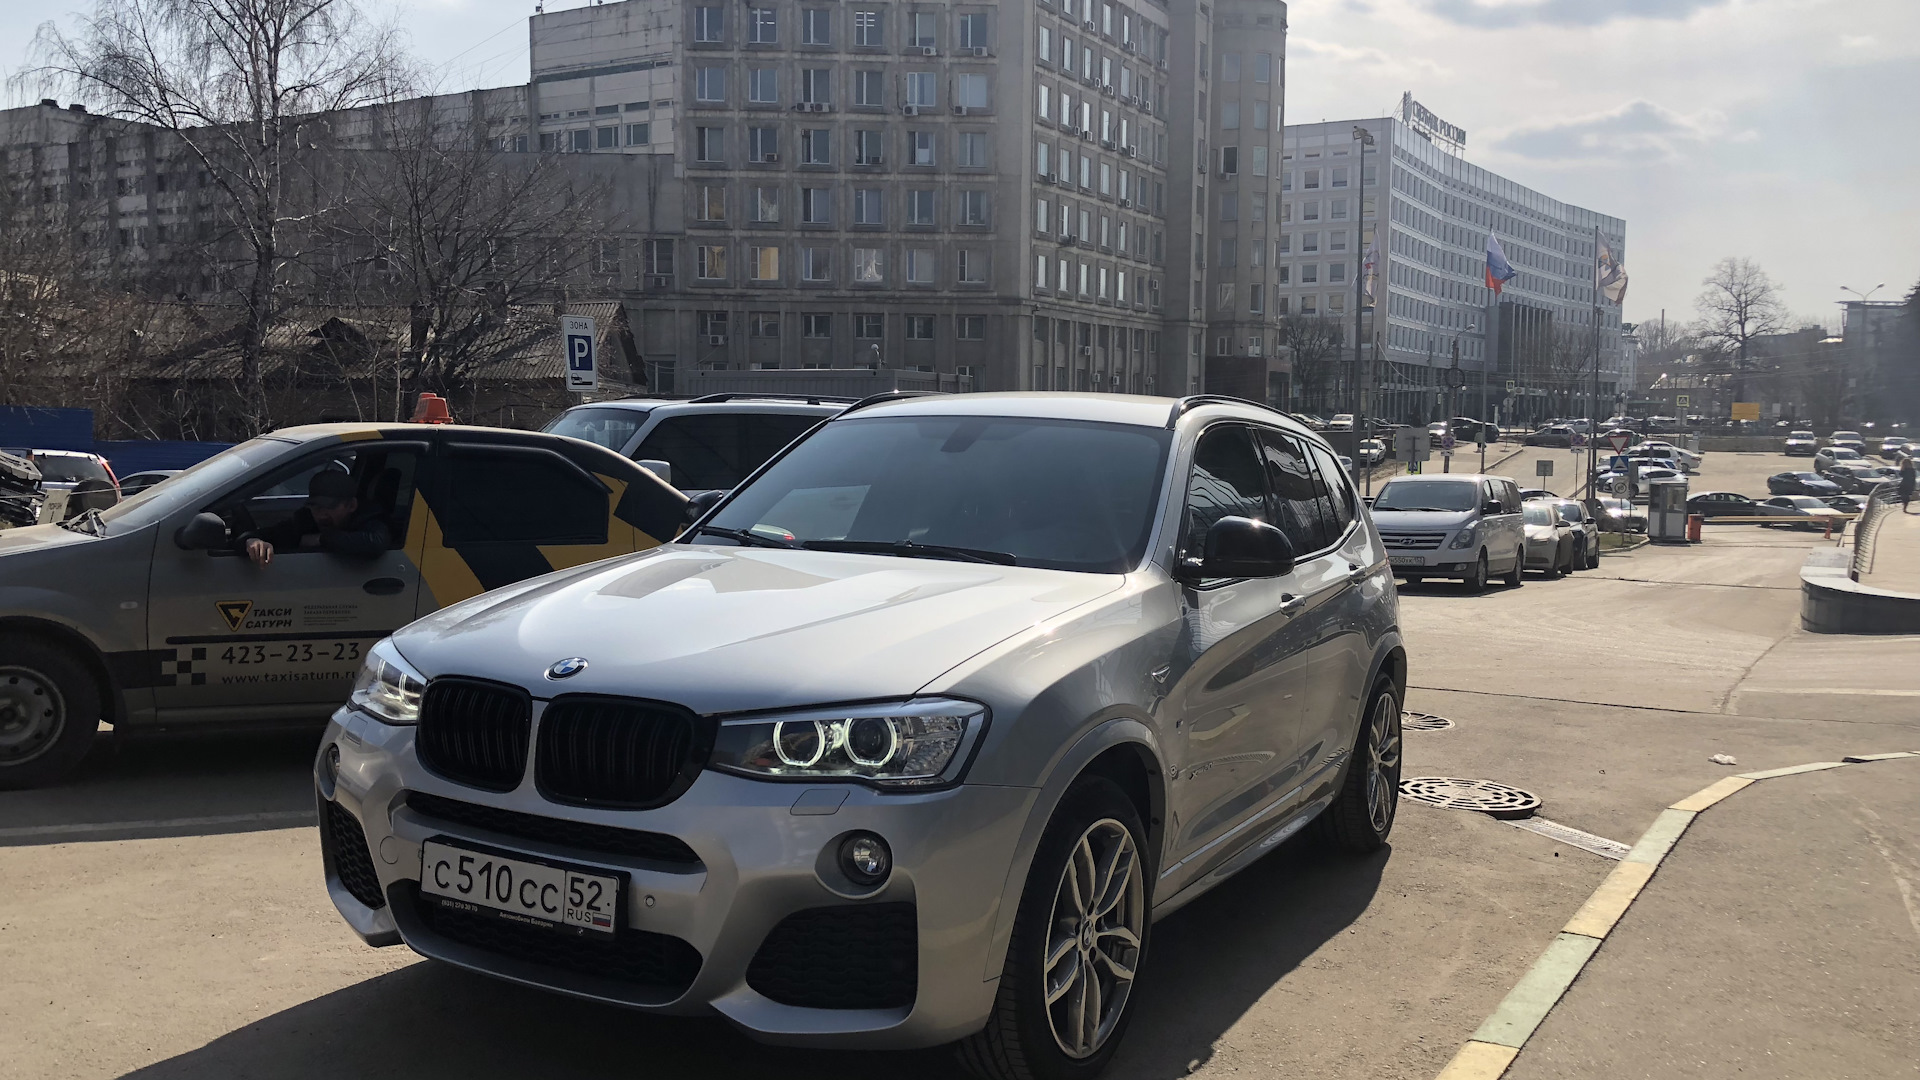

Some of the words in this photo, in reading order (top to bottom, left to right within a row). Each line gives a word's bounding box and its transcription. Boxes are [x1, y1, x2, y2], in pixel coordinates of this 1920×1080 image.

[569, 321, 589, 330] ЗОНА
[574, 338, 589, 368] P
[253, 608, 292, 618] ТАКСИ
[245, 619, 292, 629] САТУРН
[221, 642, 360, 664] 423-23-23
[569, 877, 602, 911] 52
[567, 908, 591, 923] RUS
